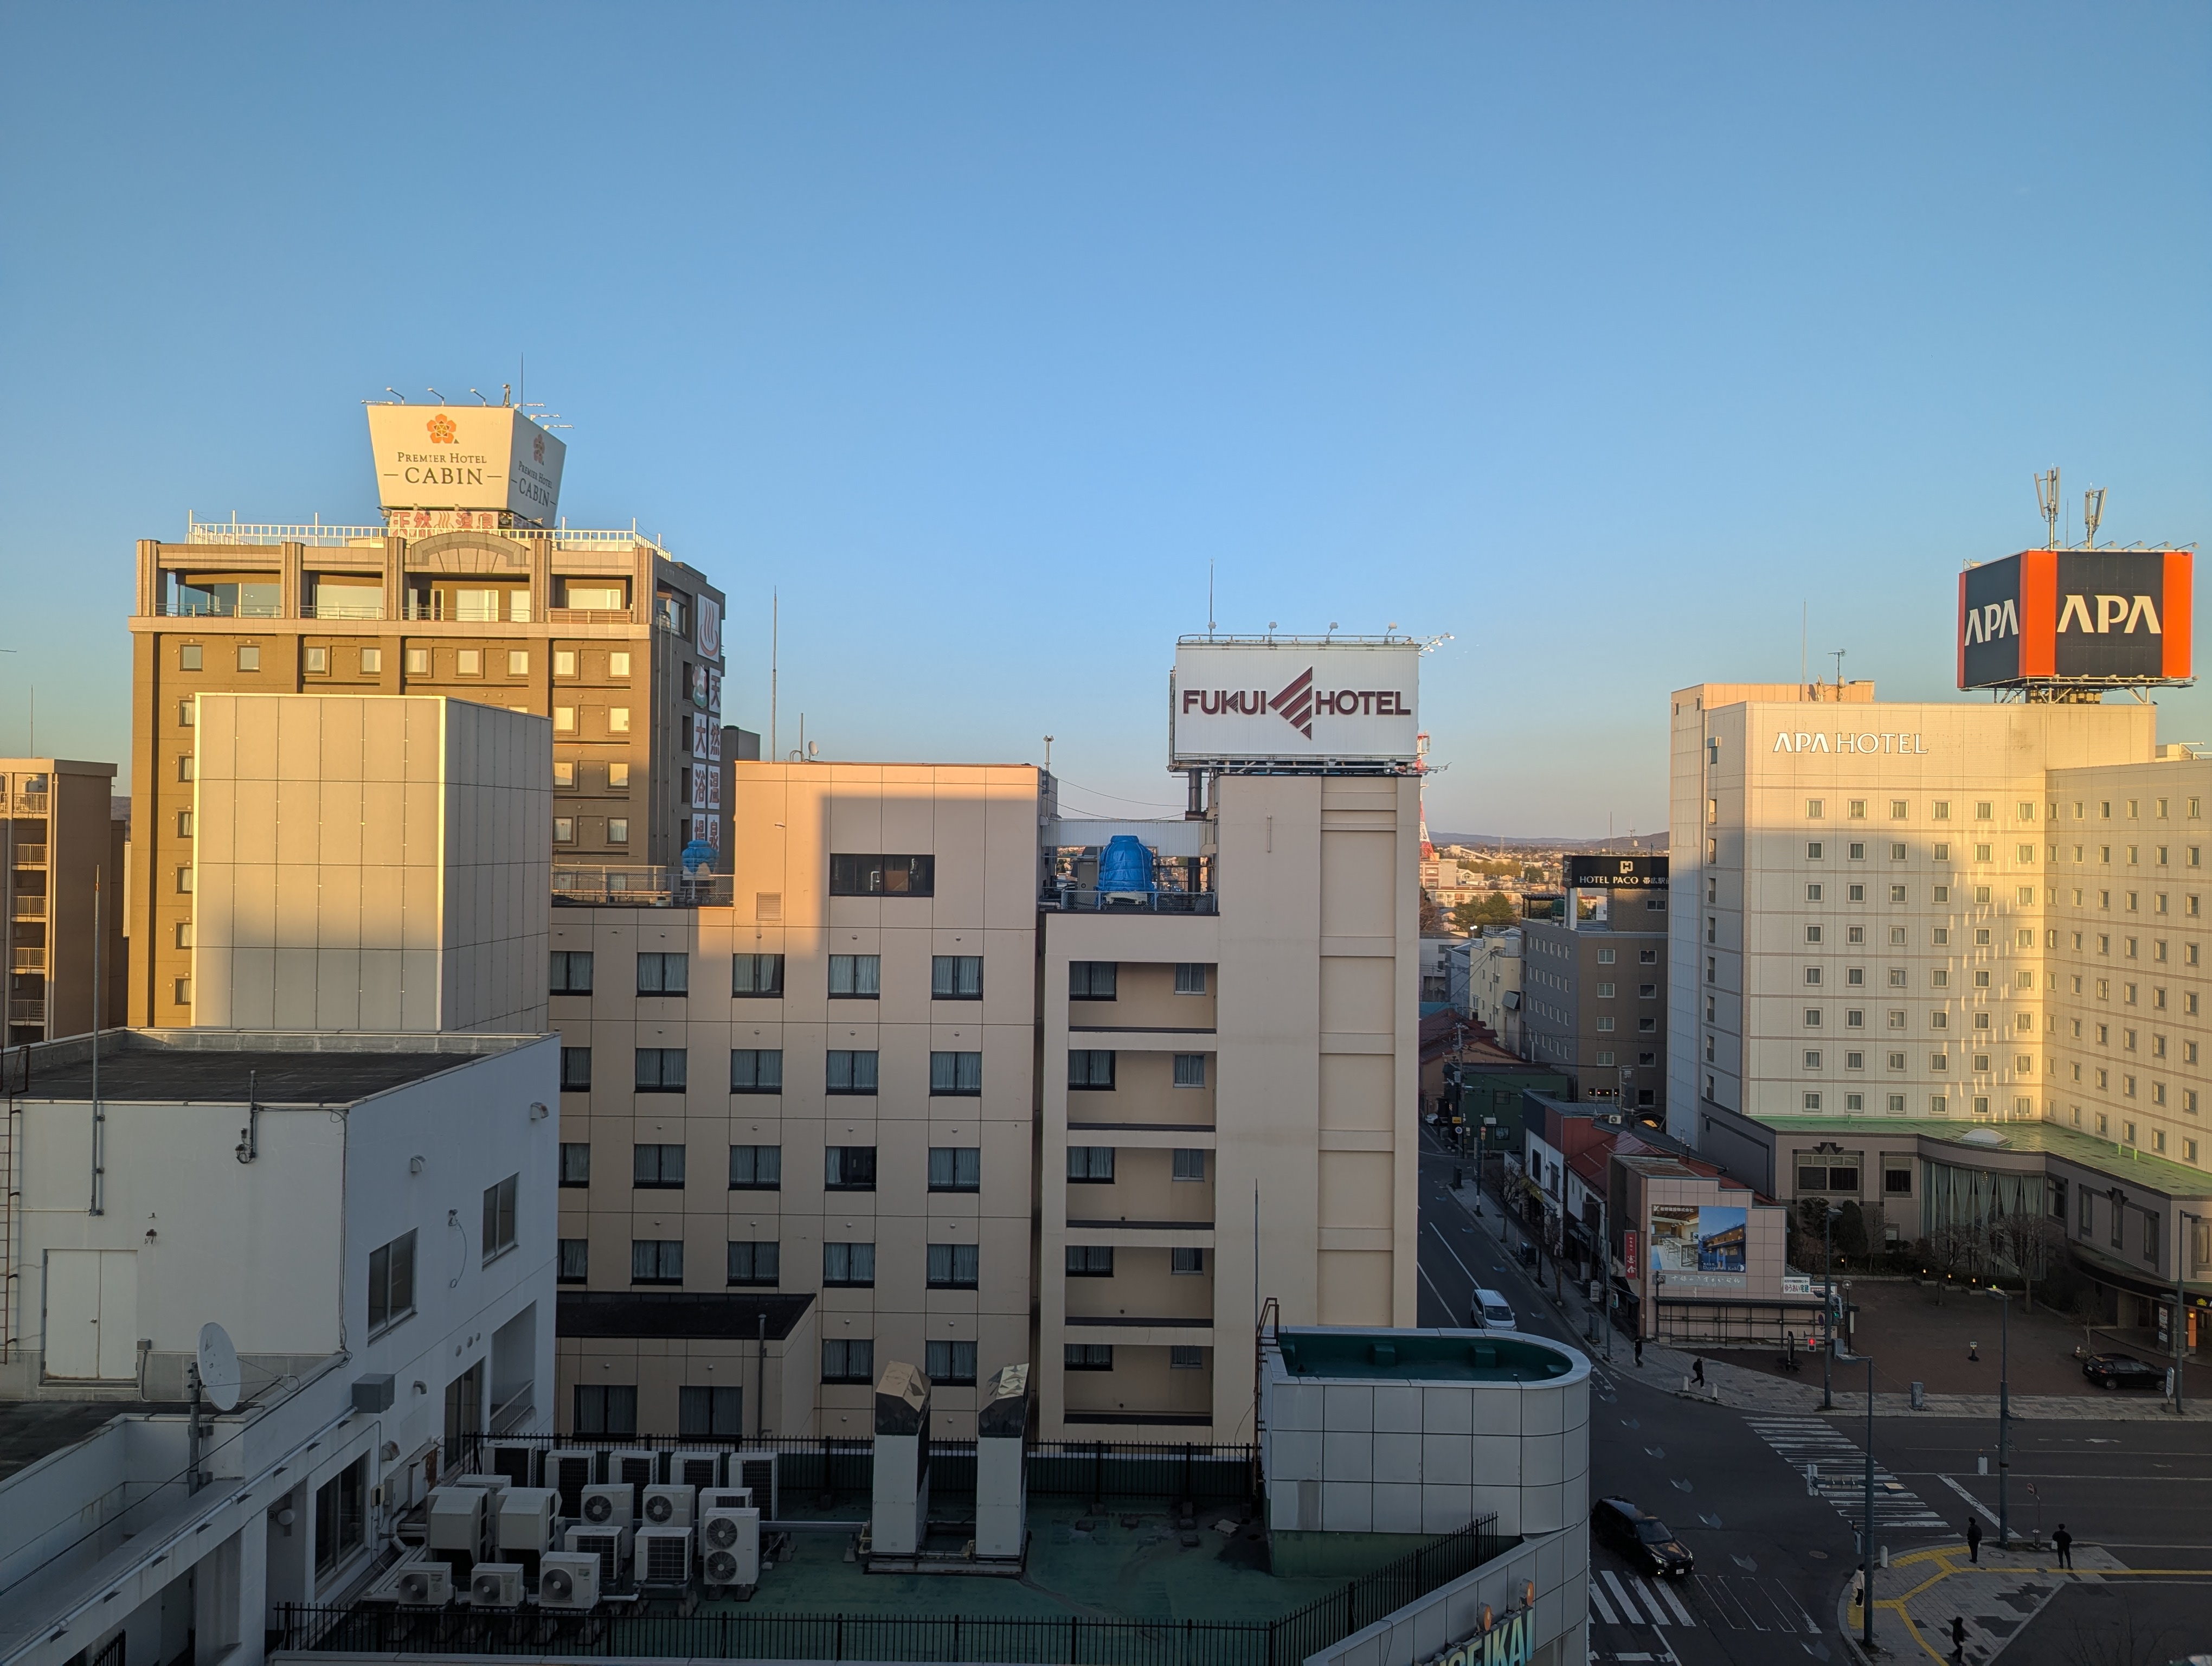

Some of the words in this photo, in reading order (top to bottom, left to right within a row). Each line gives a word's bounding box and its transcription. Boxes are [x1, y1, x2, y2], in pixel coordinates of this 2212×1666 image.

[397, 452, 445, 463] PREMIER
[449, 453, 487, 464] HOTEL
[405, 467, 483, 485] CABIN
[518, 460, 538, 480] PREMIER
[539, 472, 552, 489] HOTEL
[519, 478, 550, 507] CABIN
[1964, 598, 2019, 646] APA
[2057, 594, 2162, 634] APA
[1182, 690, 1266, 715] FUKUI
[1315, 690, 1411, 715] HOTEL
[1773, 733, 1830, 753] APA
[1835, 733, 1929, 754] HOTEL
[709, 675, 721, 850] 天然温泉
[1579, 876, 1610, 884] HOTEL
